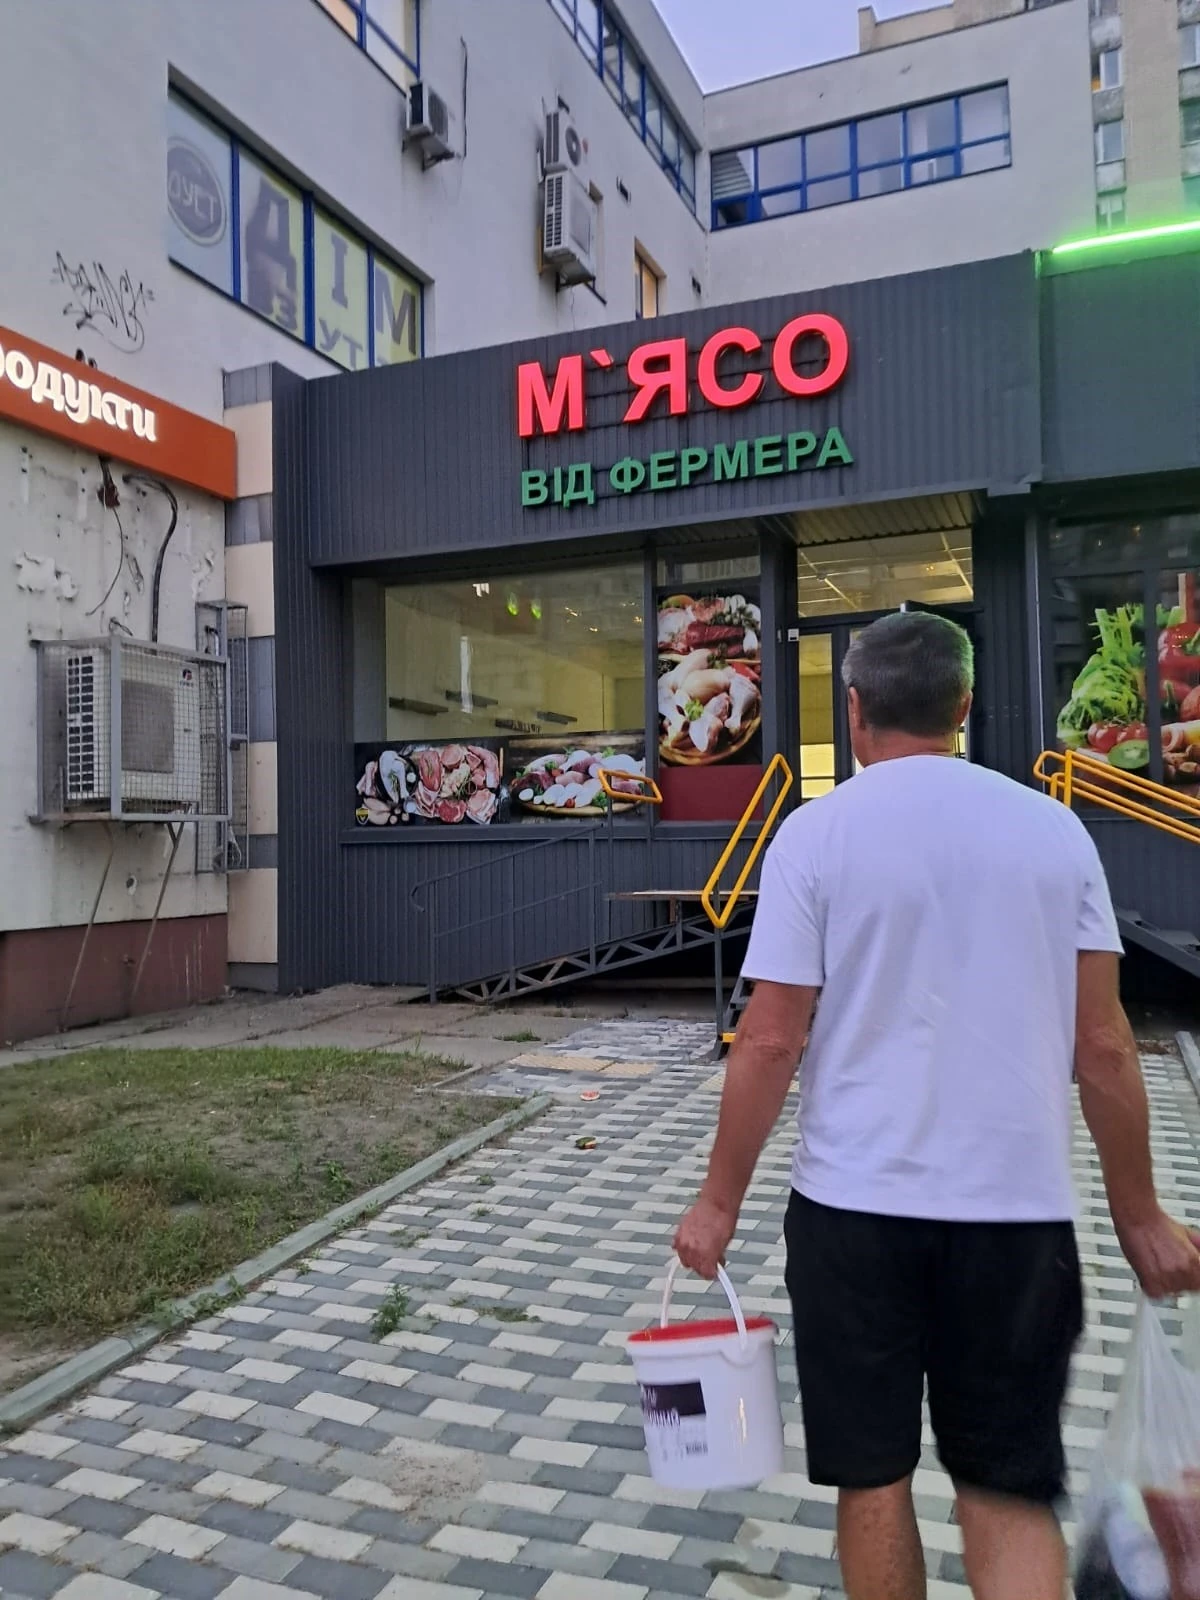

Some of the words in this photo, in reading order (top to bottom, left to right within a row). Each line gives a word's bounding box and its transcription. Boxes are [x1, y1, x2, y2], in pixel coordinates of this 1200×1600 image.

[246, 176, 417, 356] ДІМ
[0, 344, 157, 442] одукти
[521, 463, 595, 508] ВІД
[609, 426, 854, 494] ФЕРМЕРА
